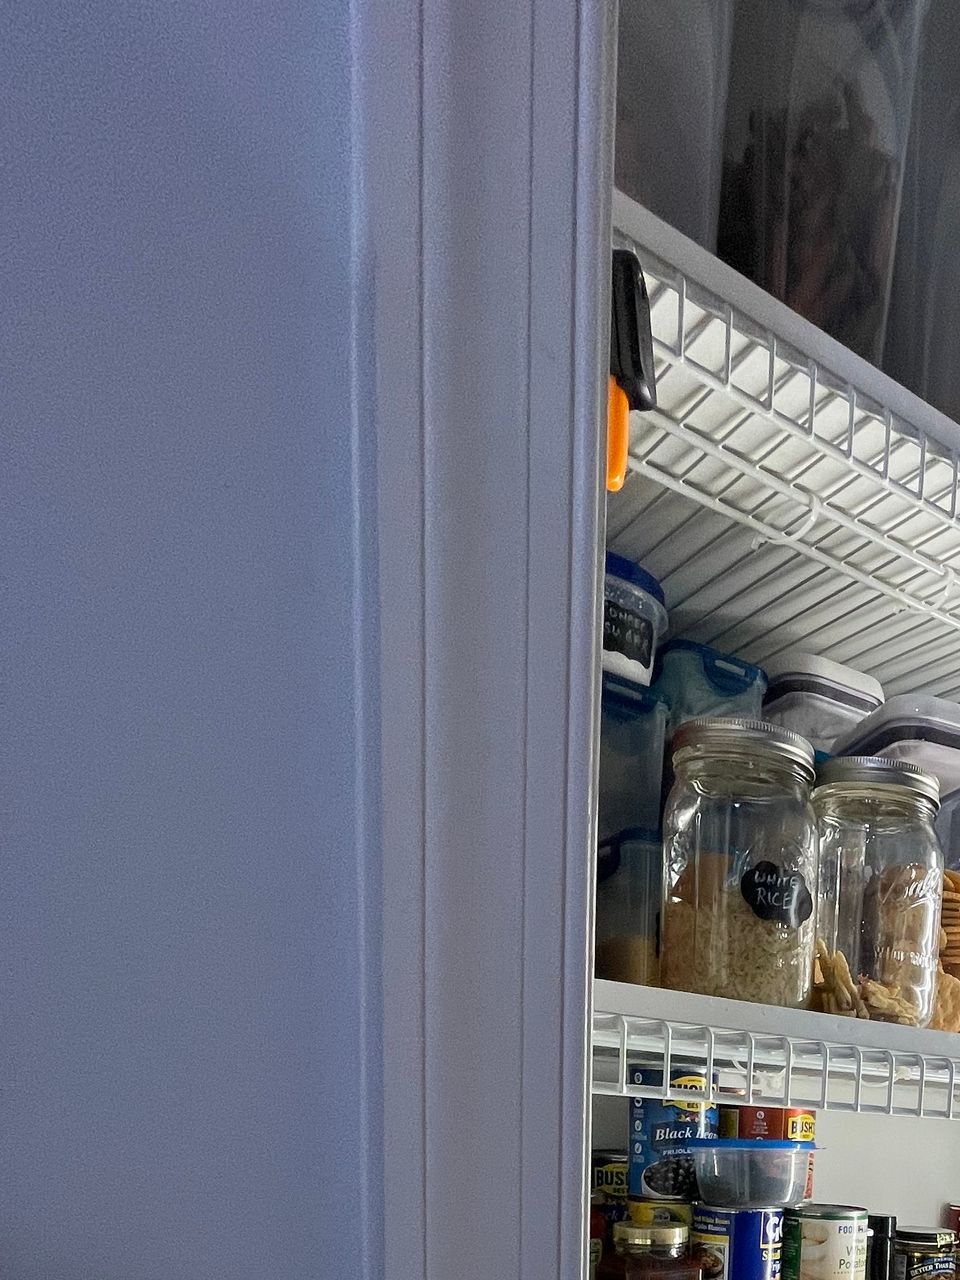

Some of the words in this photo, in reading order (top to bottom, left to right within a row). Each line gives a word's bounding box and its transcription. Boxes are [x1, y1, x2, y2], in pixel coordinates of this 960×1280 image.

[754, 871, 800, 888] WHITE
[756, 887, 792, 910] RICE
[655, 1127, 693, 1142] Black
[910, 1262, 934, 1277] BETTER
